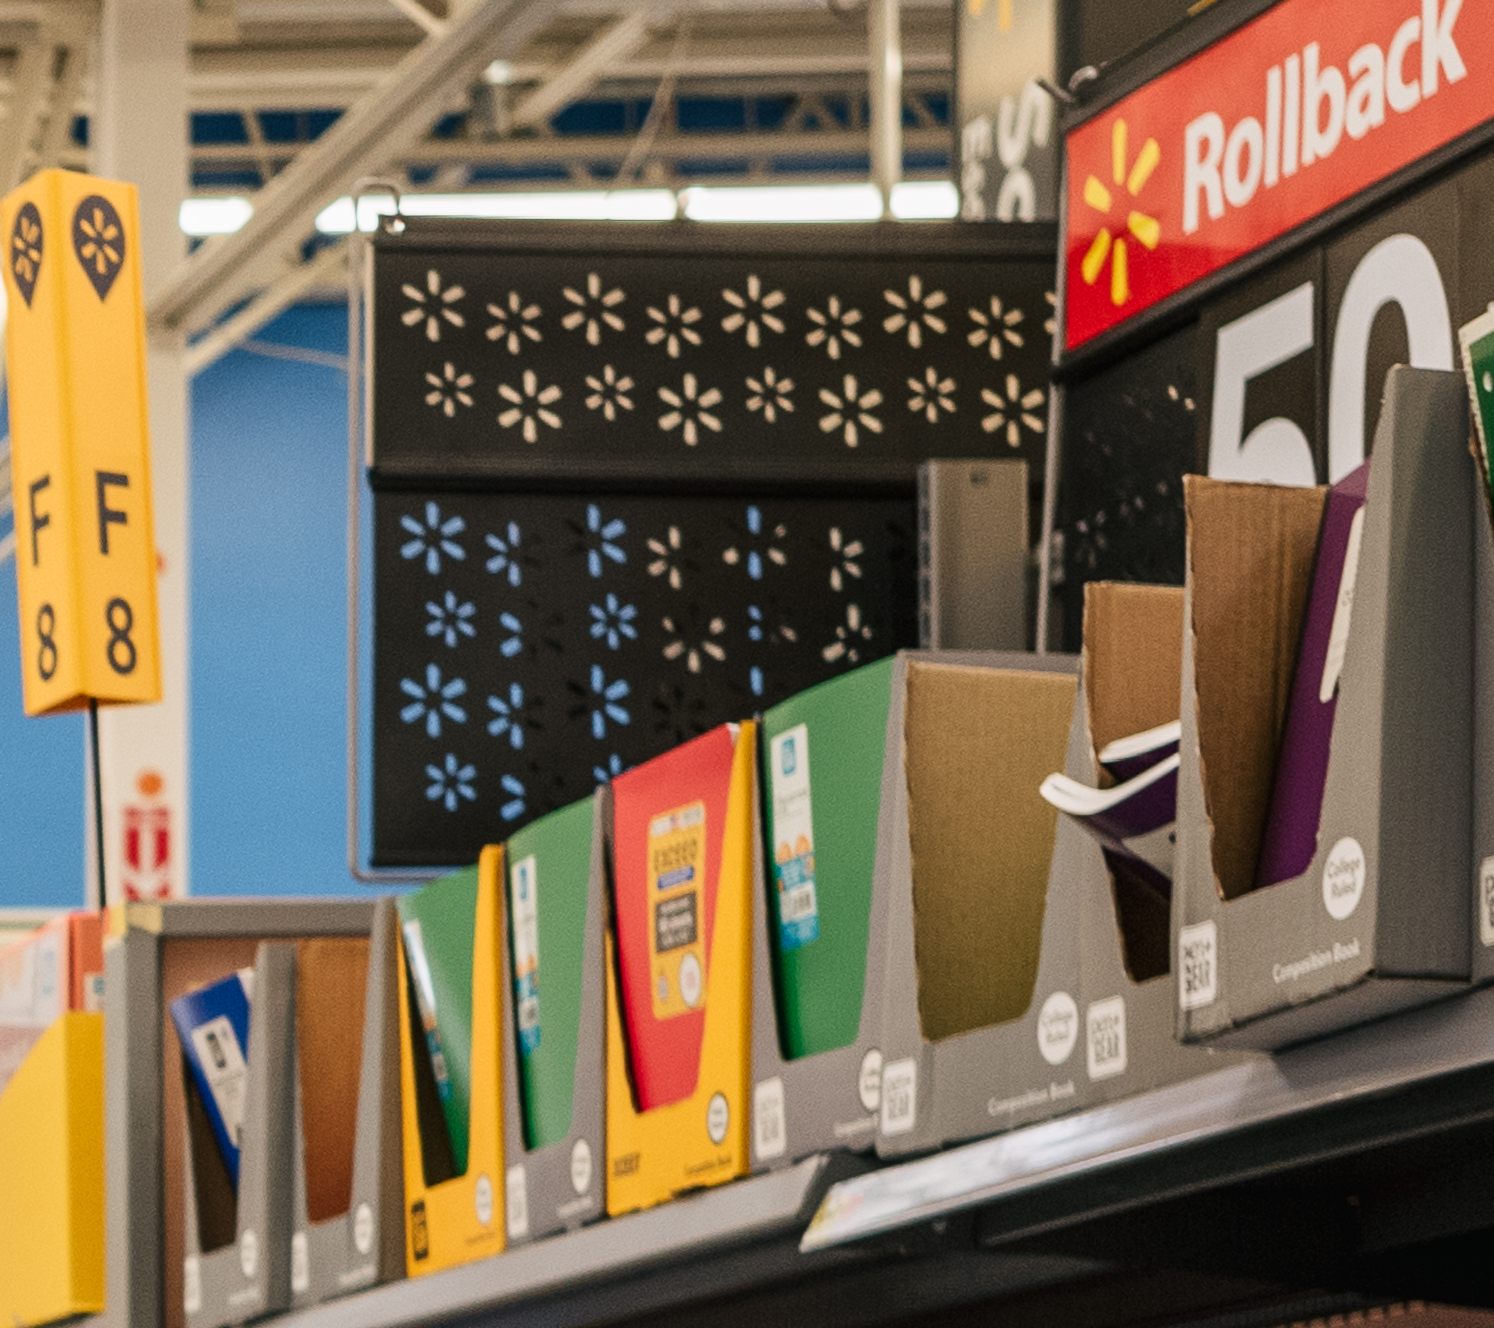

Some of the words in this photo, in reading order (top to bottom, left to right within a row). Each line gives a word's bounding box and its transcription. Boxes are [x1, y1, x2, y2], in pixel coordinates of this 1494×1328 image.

[1182, 0, 1468, 235] Rollback
[28, 473, 53, 567] F
[93, 469, 131, 556] F
[36, 602, 60, 682] 8
[103, 596, 138, 676] 8
